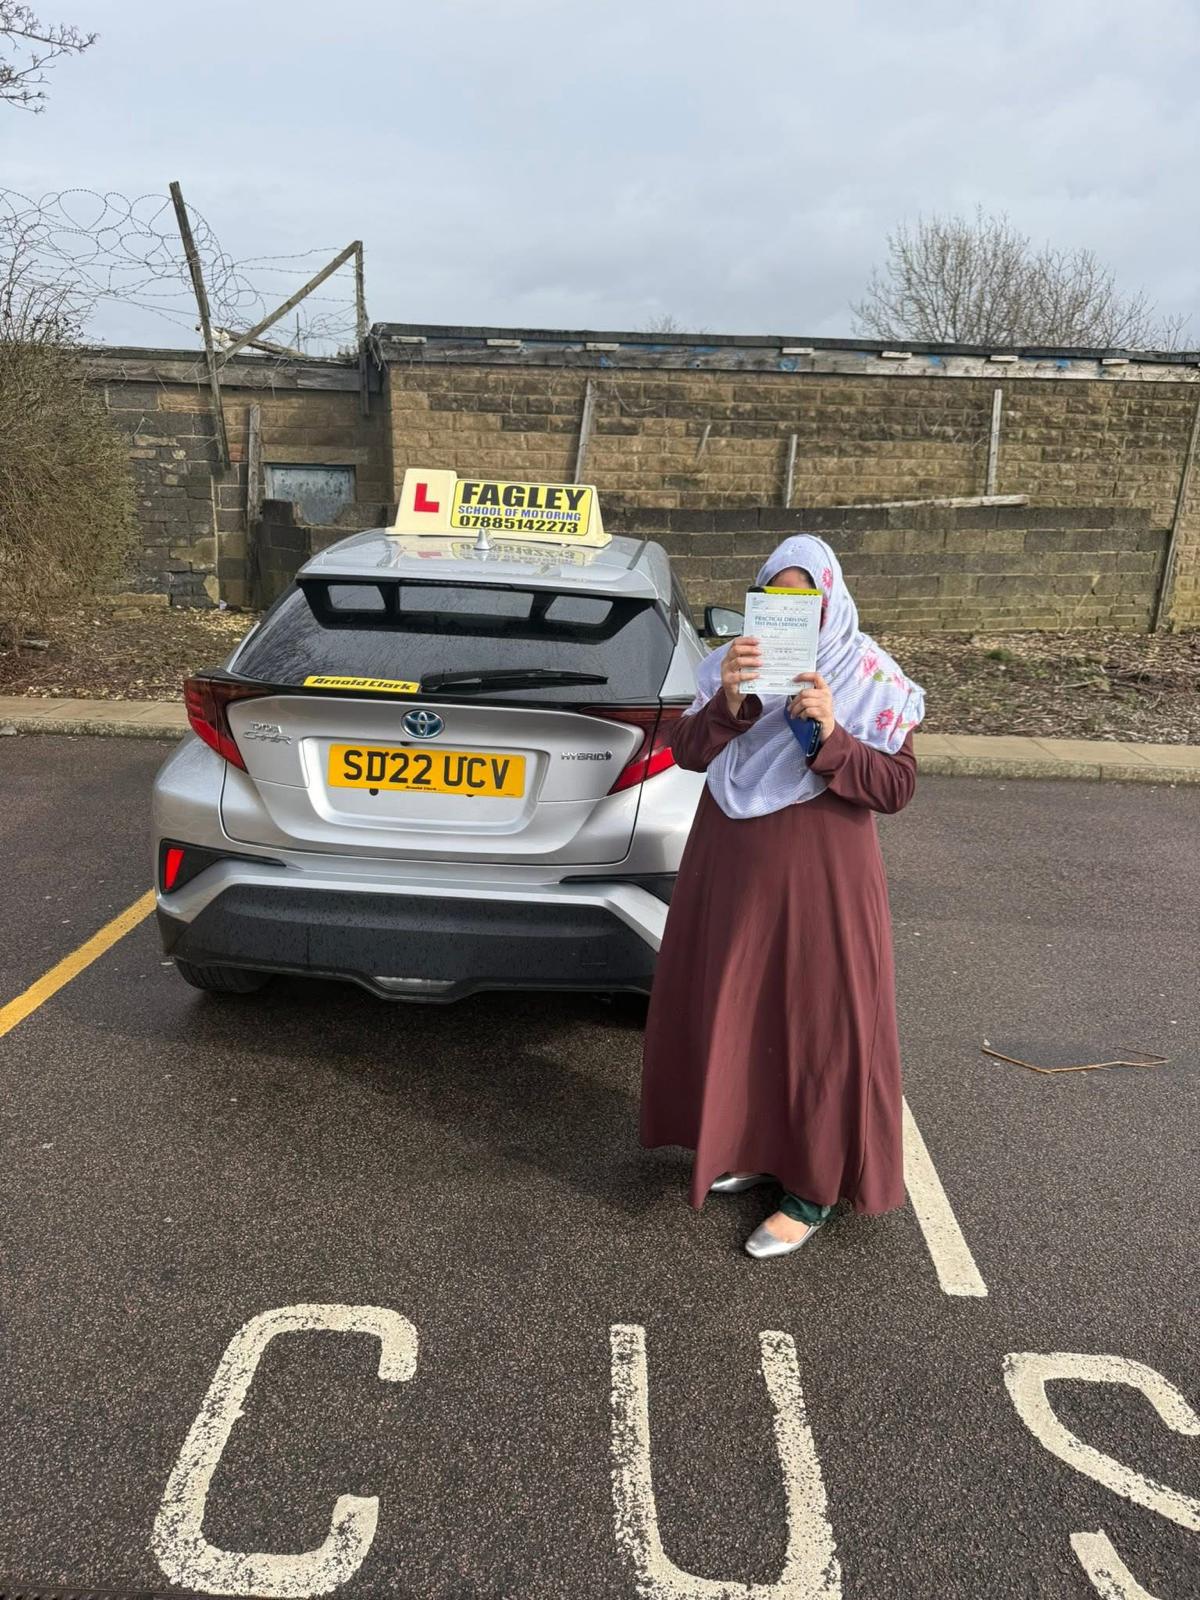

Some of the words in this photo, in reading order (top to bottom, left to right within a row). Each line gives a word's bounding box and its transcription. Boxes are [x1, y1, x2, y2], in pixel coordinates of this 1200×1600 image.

[413, 482, 440, 513] L
[461, 482, 586, 512] FAGLEY
[458, 505, 503, 517] SCHOOL
[505, 507, 518, 518] OF
[520, 509, 582, 522] MOTORING
[459, 516, 579, 534] 07885142273
[783, 616, 809, 624] DRIVING
[312, 678, 369, 687] Arnold
[368, 680, 413, 690] Clark
[561, 751, 605, 761] HYBRID
[343, 749, 433, 785] SD22
[443, 755, 510, 790] UCV
